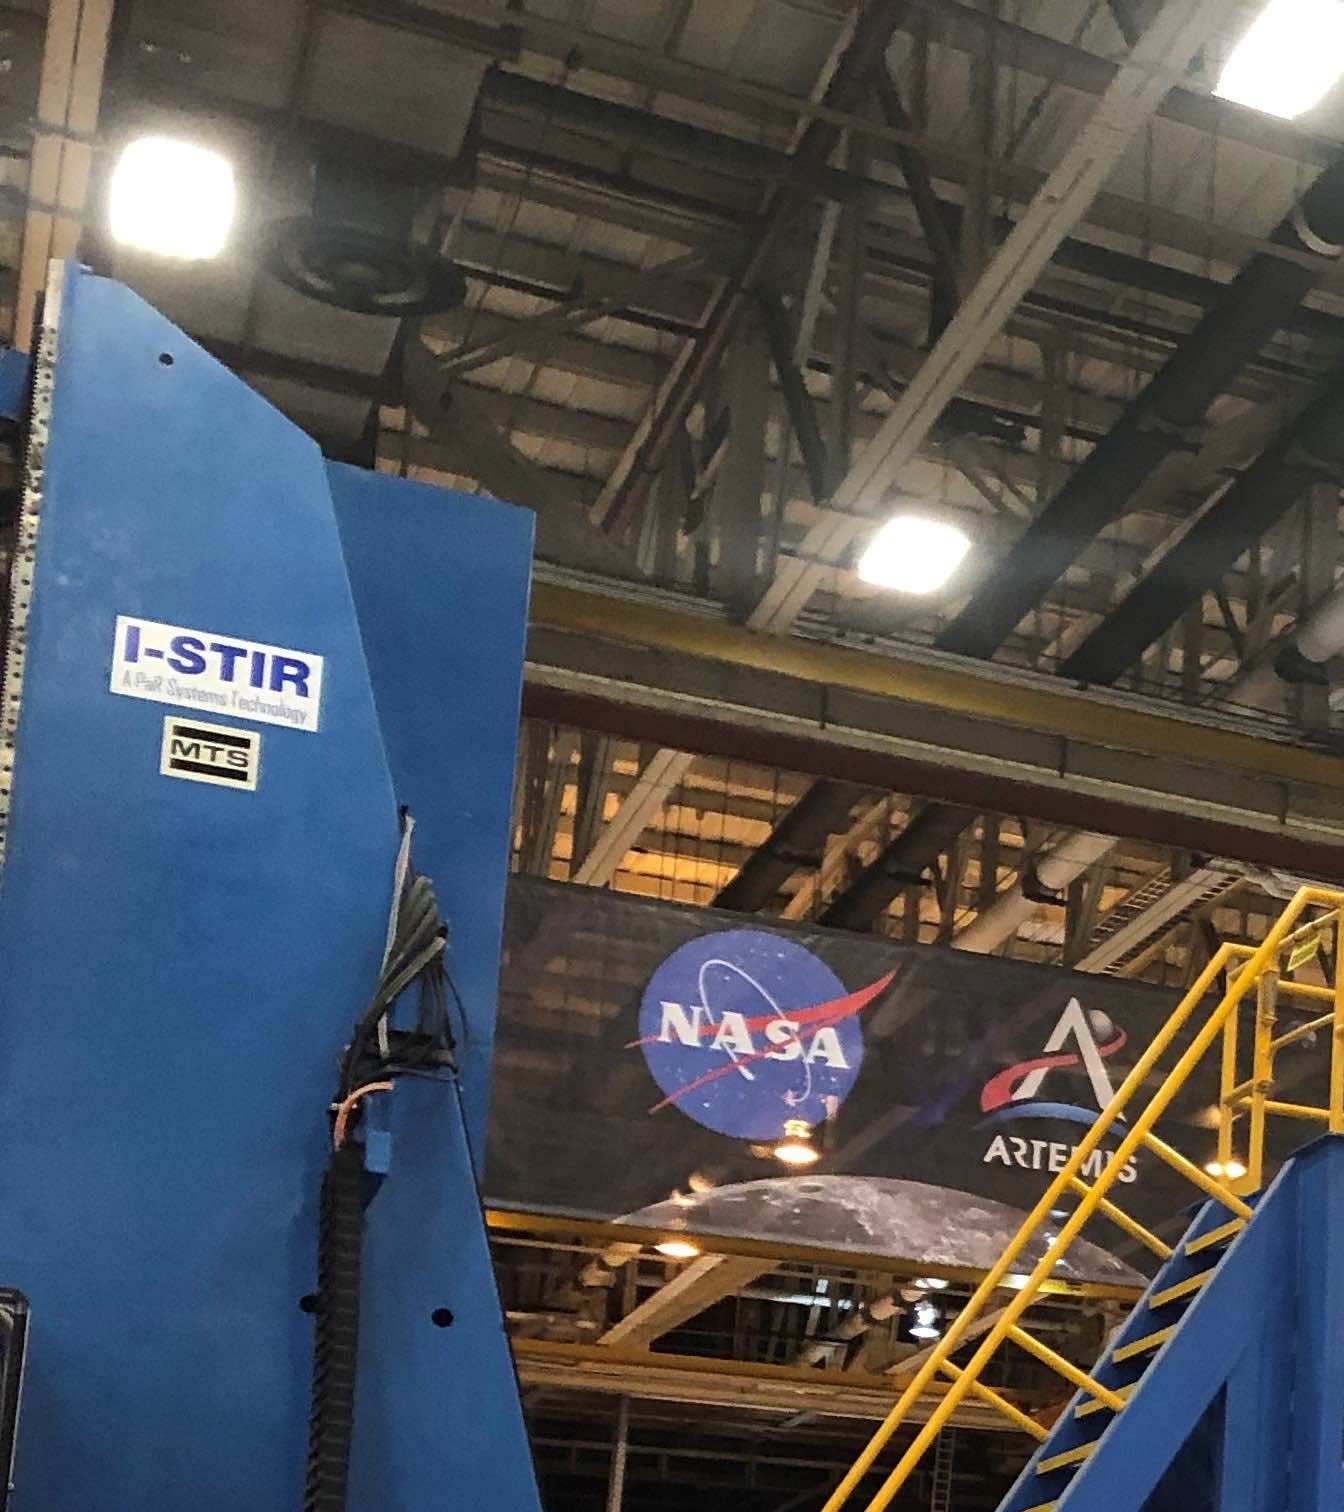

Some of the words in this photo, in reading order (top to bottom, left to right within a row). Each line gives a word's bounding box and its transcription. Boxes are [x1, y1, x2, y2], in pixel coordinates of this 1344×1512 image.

[124, 625, 310, 697] I-STIR
[166, 677, 226, 706] Systems
[231, 690, 308, 725] Technology
[171, 739, 249, 768] MTS
[657, 1001, 851, 1069] NASA
